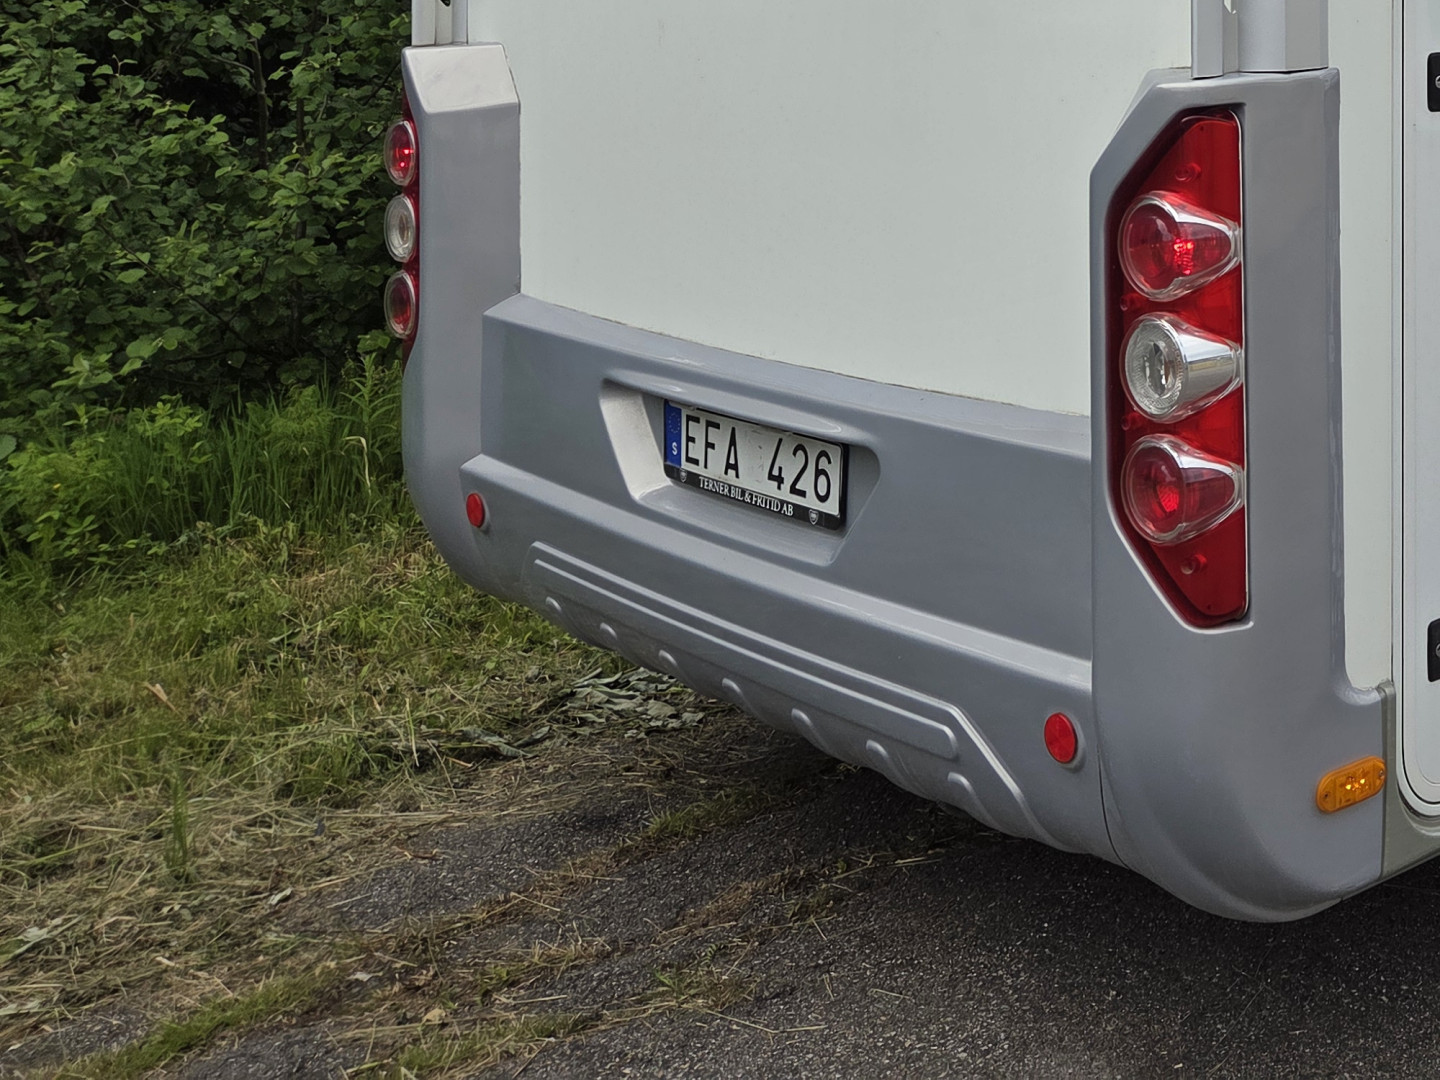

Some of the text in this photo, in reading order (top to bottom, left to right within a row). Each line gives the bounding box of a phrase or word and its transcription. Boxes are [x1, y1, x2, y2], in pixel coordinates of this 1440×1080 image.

[671, 441, 678, 456] S
[684, 413, 833, 504] EFA 426
[699, 476, 794, 517] TERNER BIL & FRITID AB
